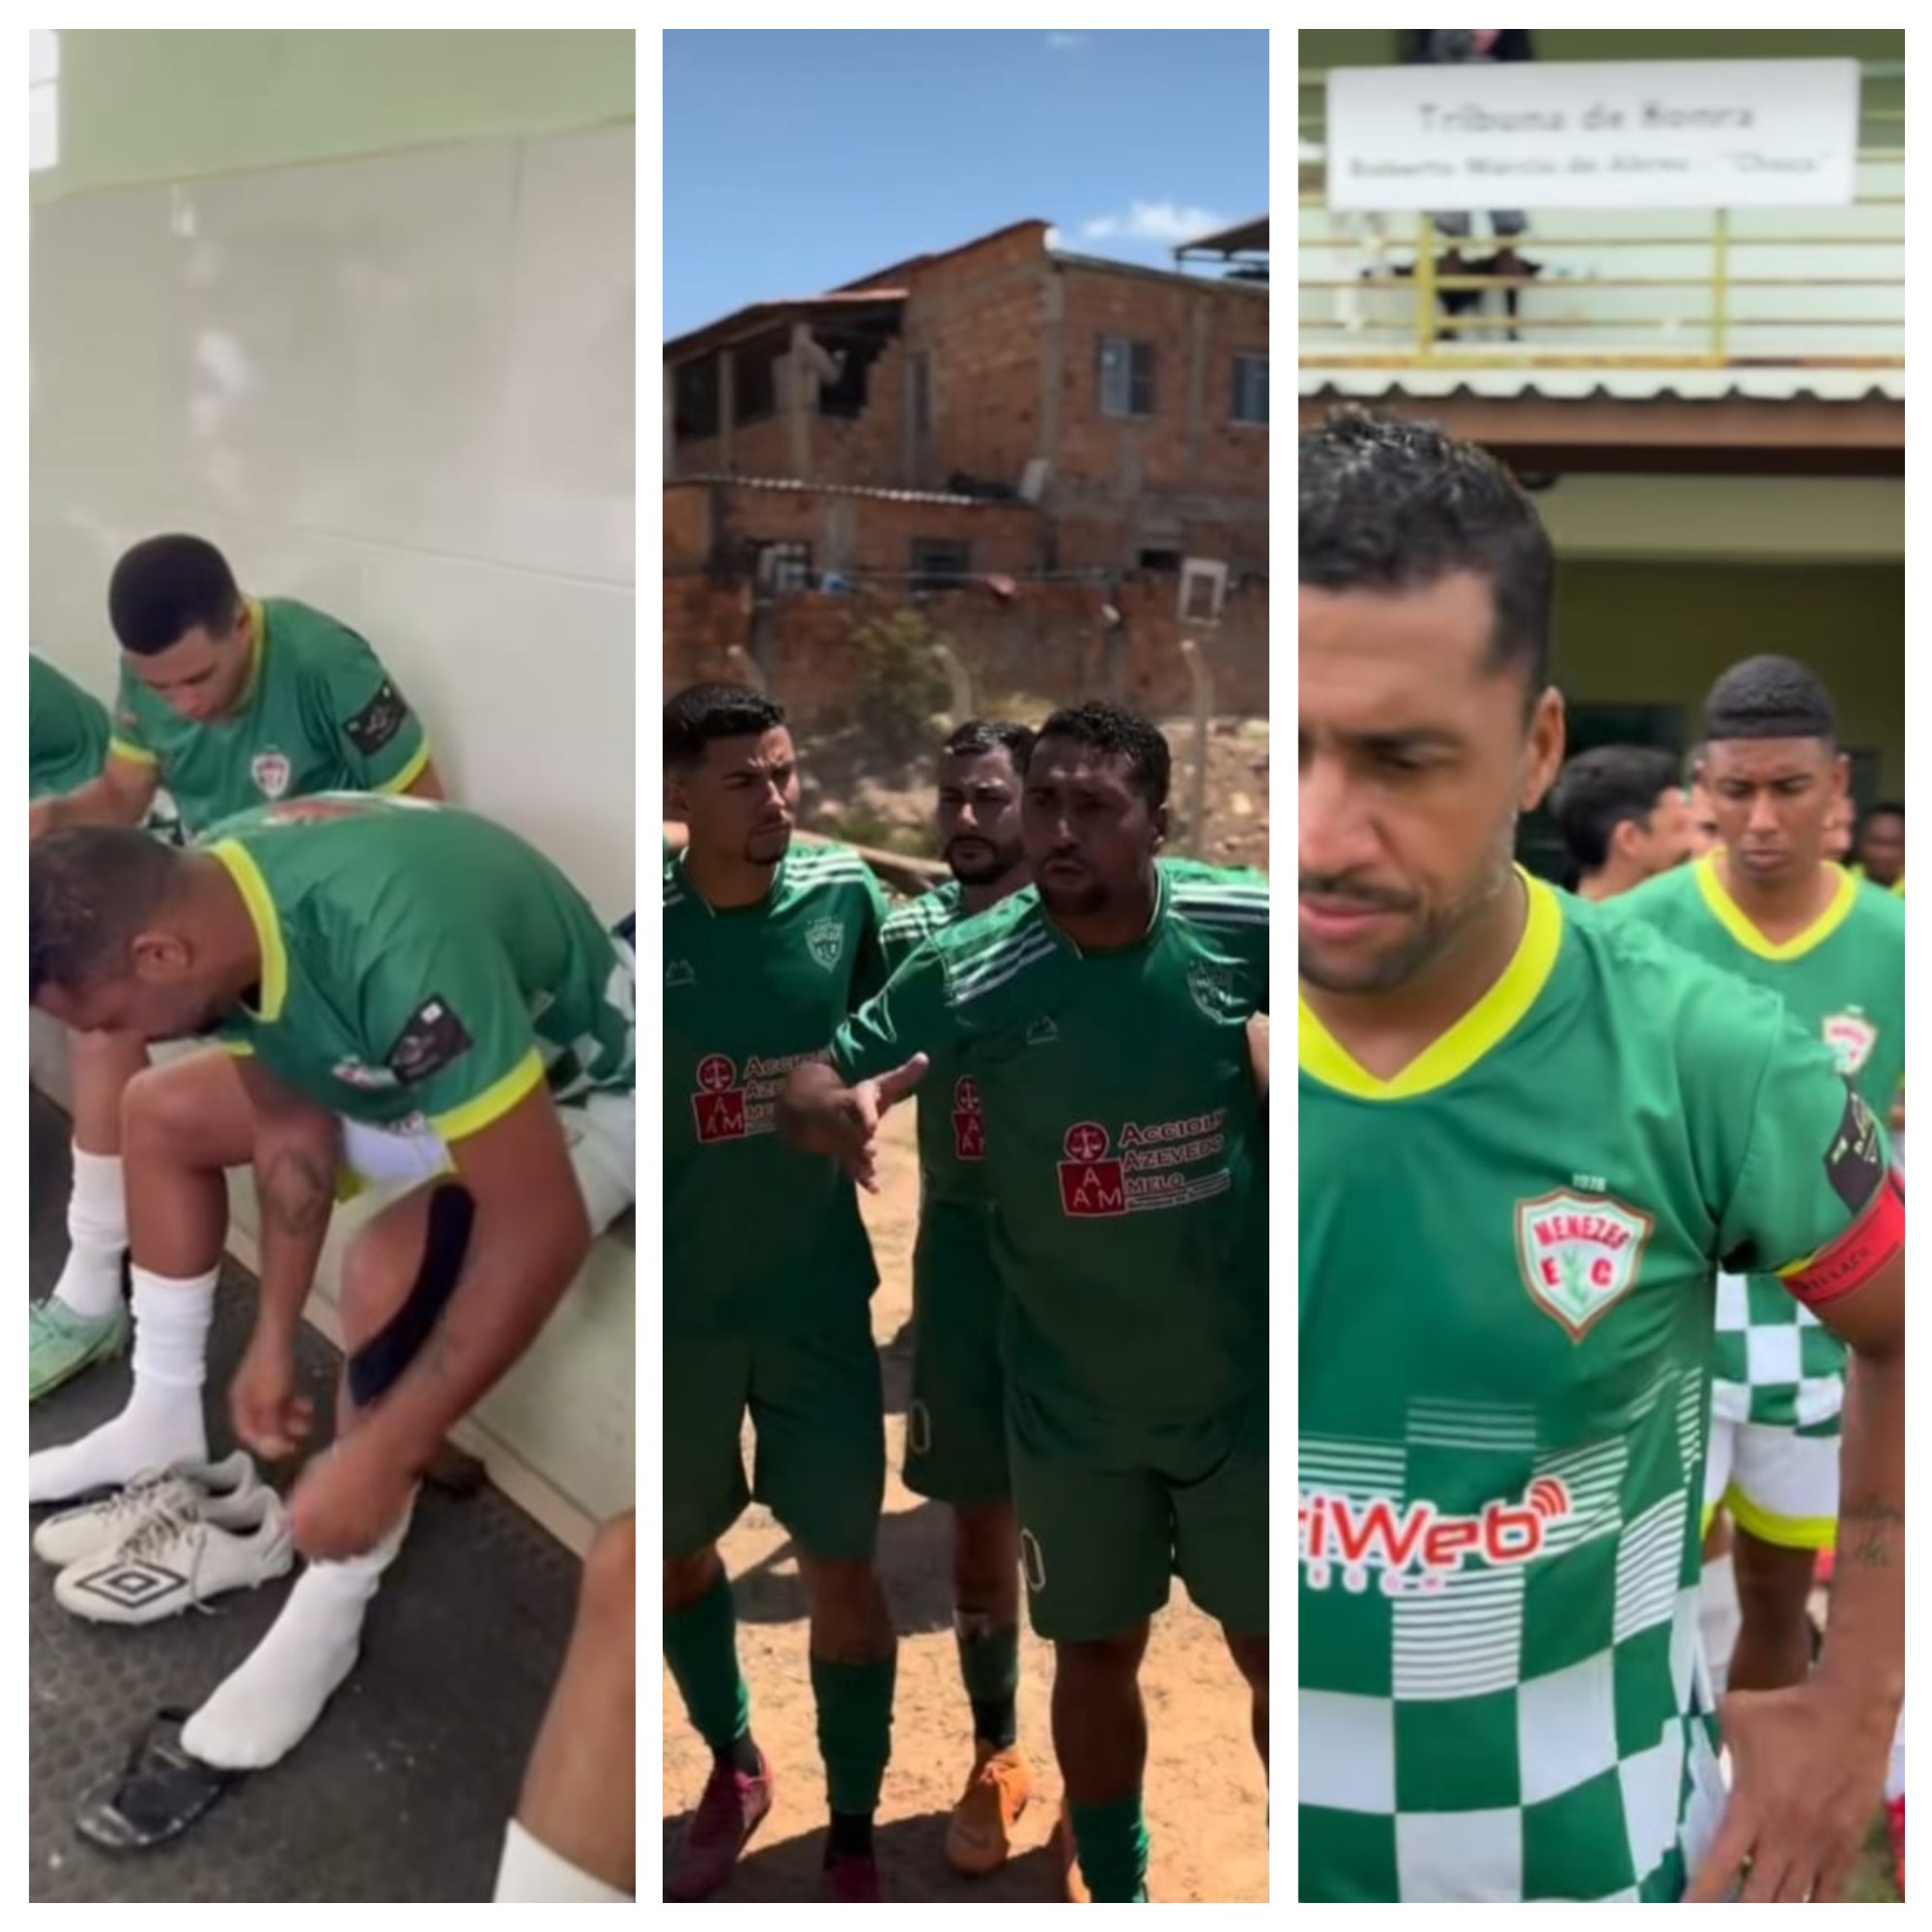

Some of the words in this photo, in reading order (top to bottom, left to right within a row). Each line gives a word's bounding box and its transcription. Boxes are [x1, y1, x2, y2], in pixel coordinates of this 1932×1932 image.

[1417, 102, 1567, 132] Tribuna
[1579, 100, 1626, 131] de
[1540, 1257, 1561, 1287] E
[1590, 1258, 1612, 1287] C
